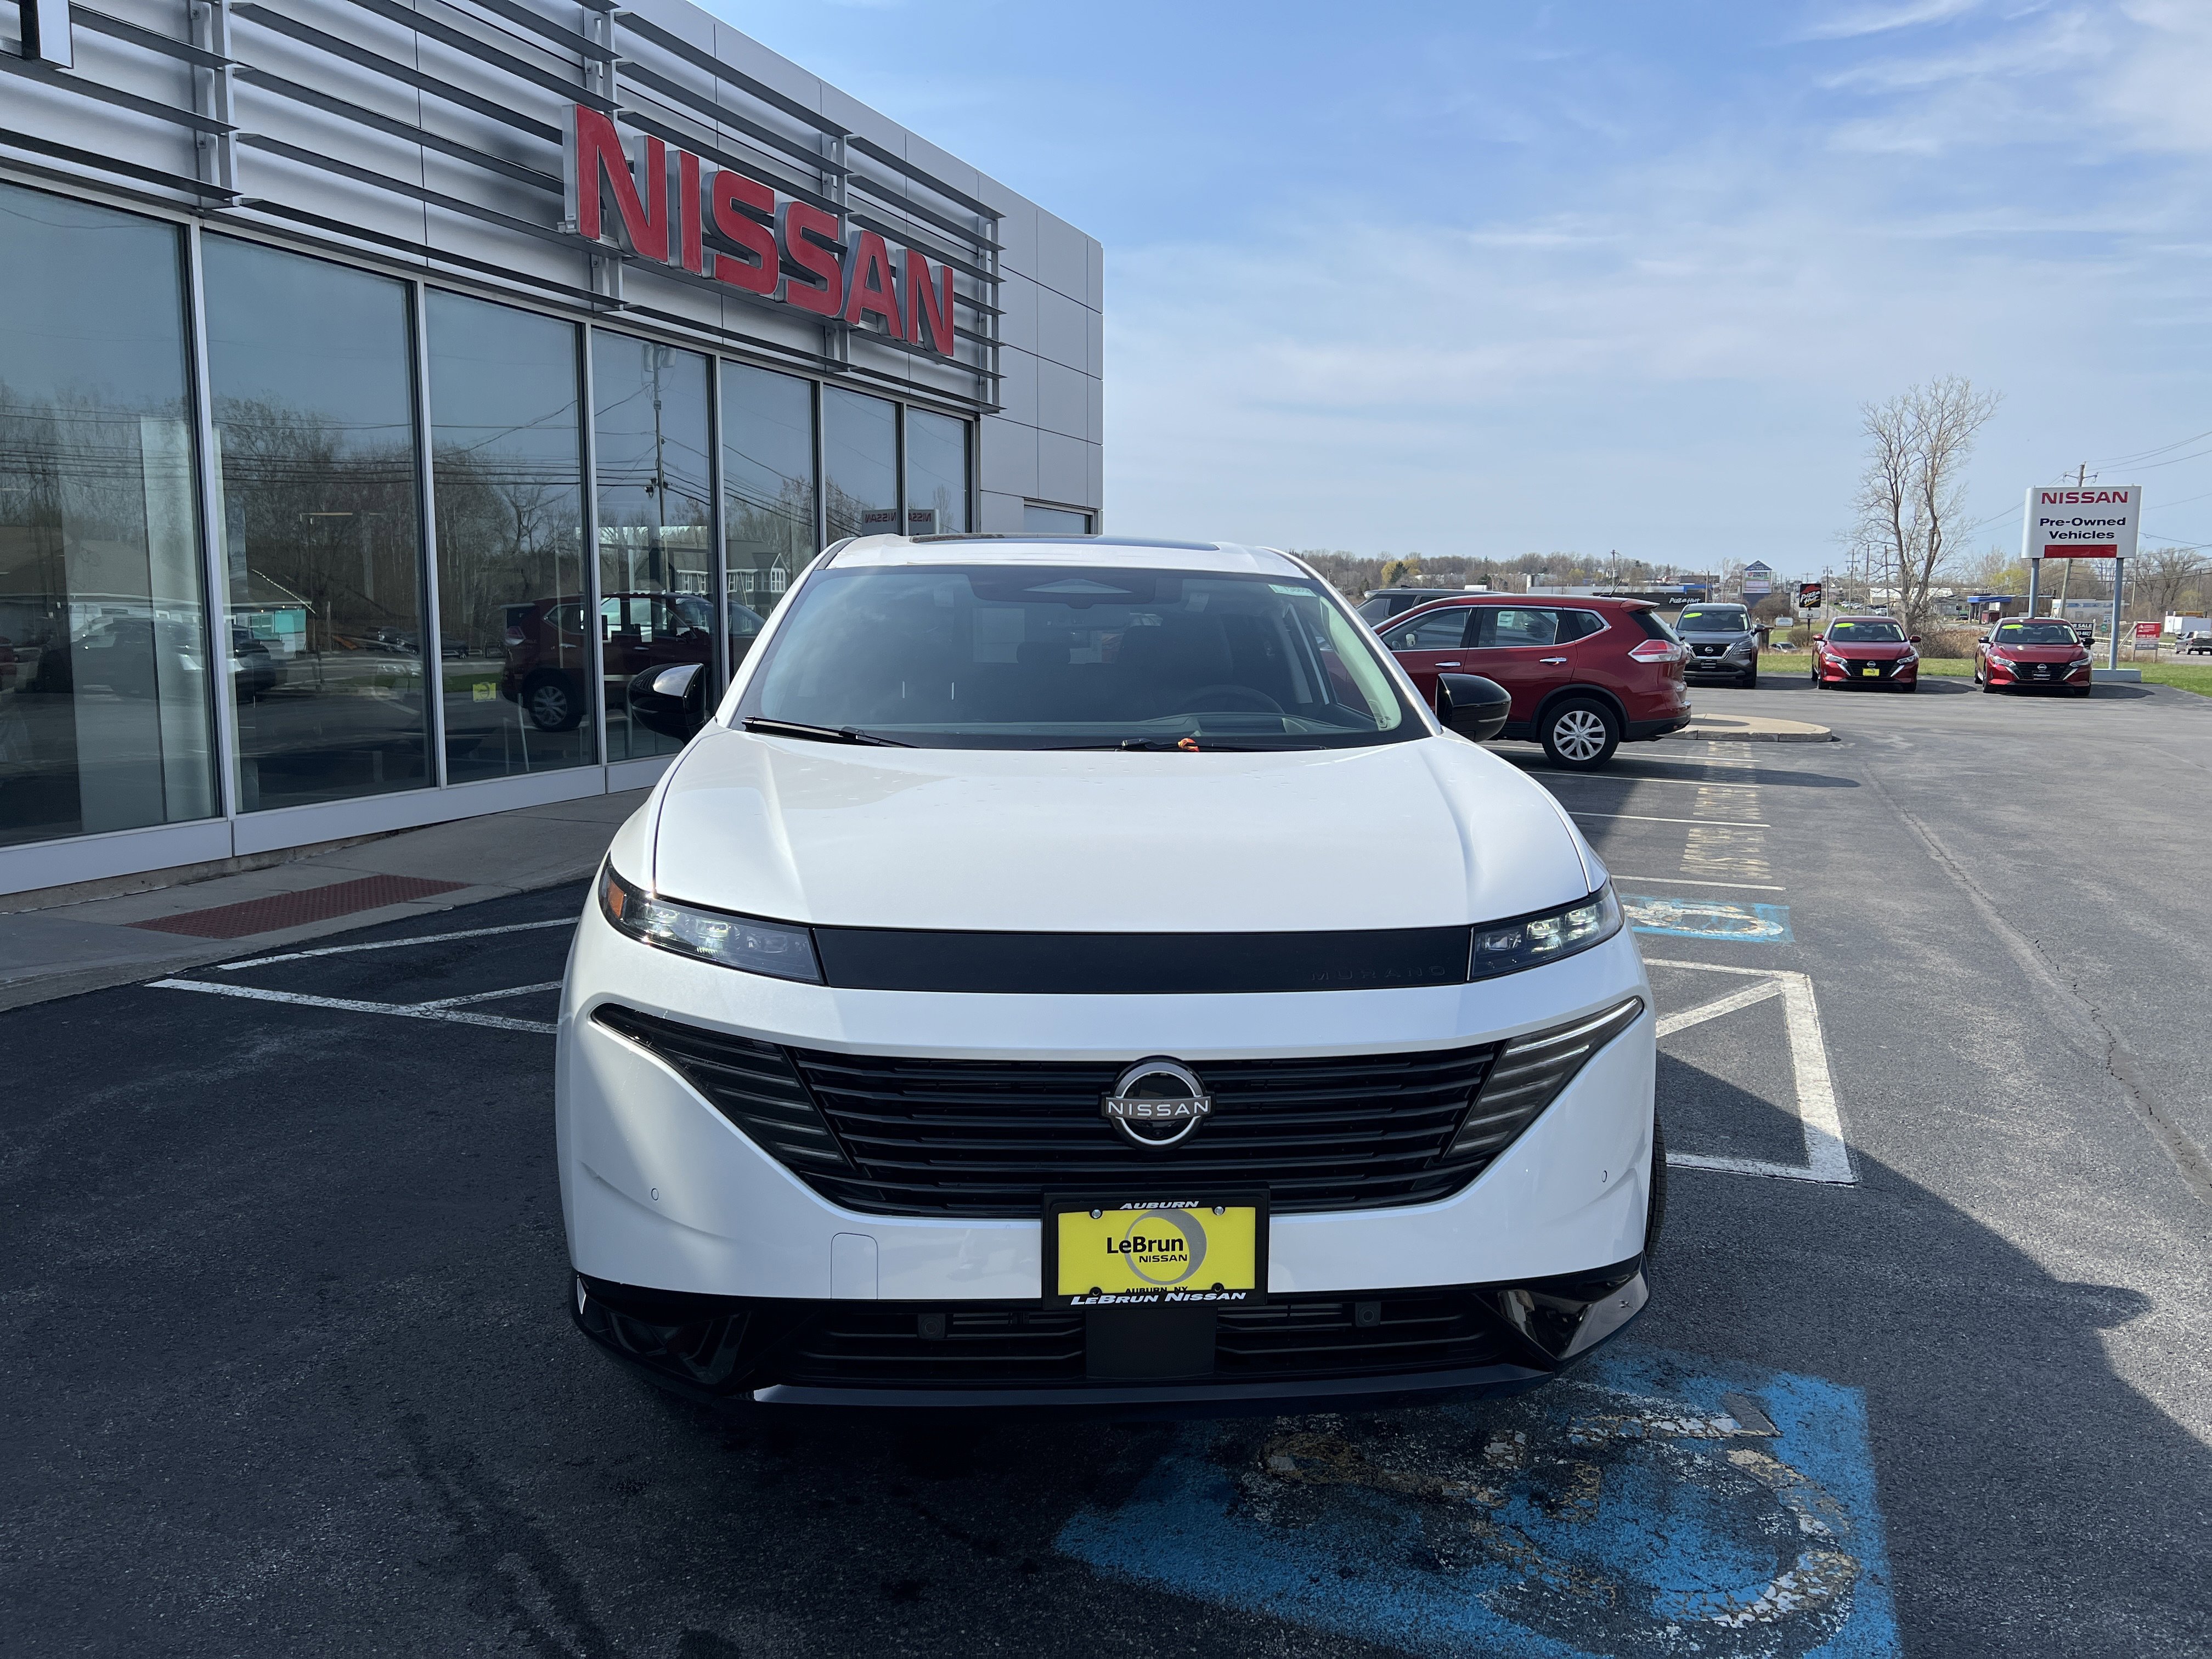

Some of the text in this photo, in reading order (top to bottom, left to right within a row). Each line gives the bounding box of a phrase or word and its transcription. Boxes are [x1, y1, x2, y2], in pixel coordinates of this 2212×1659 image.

[562, 103, 953, 357] NISSAN
[2041, 492, 2128, 504] NISSAN
[2040, 517, 2126, 526] Pre-Owned
[2049, 531, 2115, 539] Vehicles
[1800, 591, 1820, 602] Pizza
[1804, 595, 1819, 605] Hut
[1311, 966, 1445, 980] MURANO
[1108, 1100, 1209, 1116] NISSAN
[1119, 1201, 1199, 1210] AUBURN
[1107, 1237, 1183, 1254] LeBrun
[1139, 1255, 1187, 1263] NISSAN
